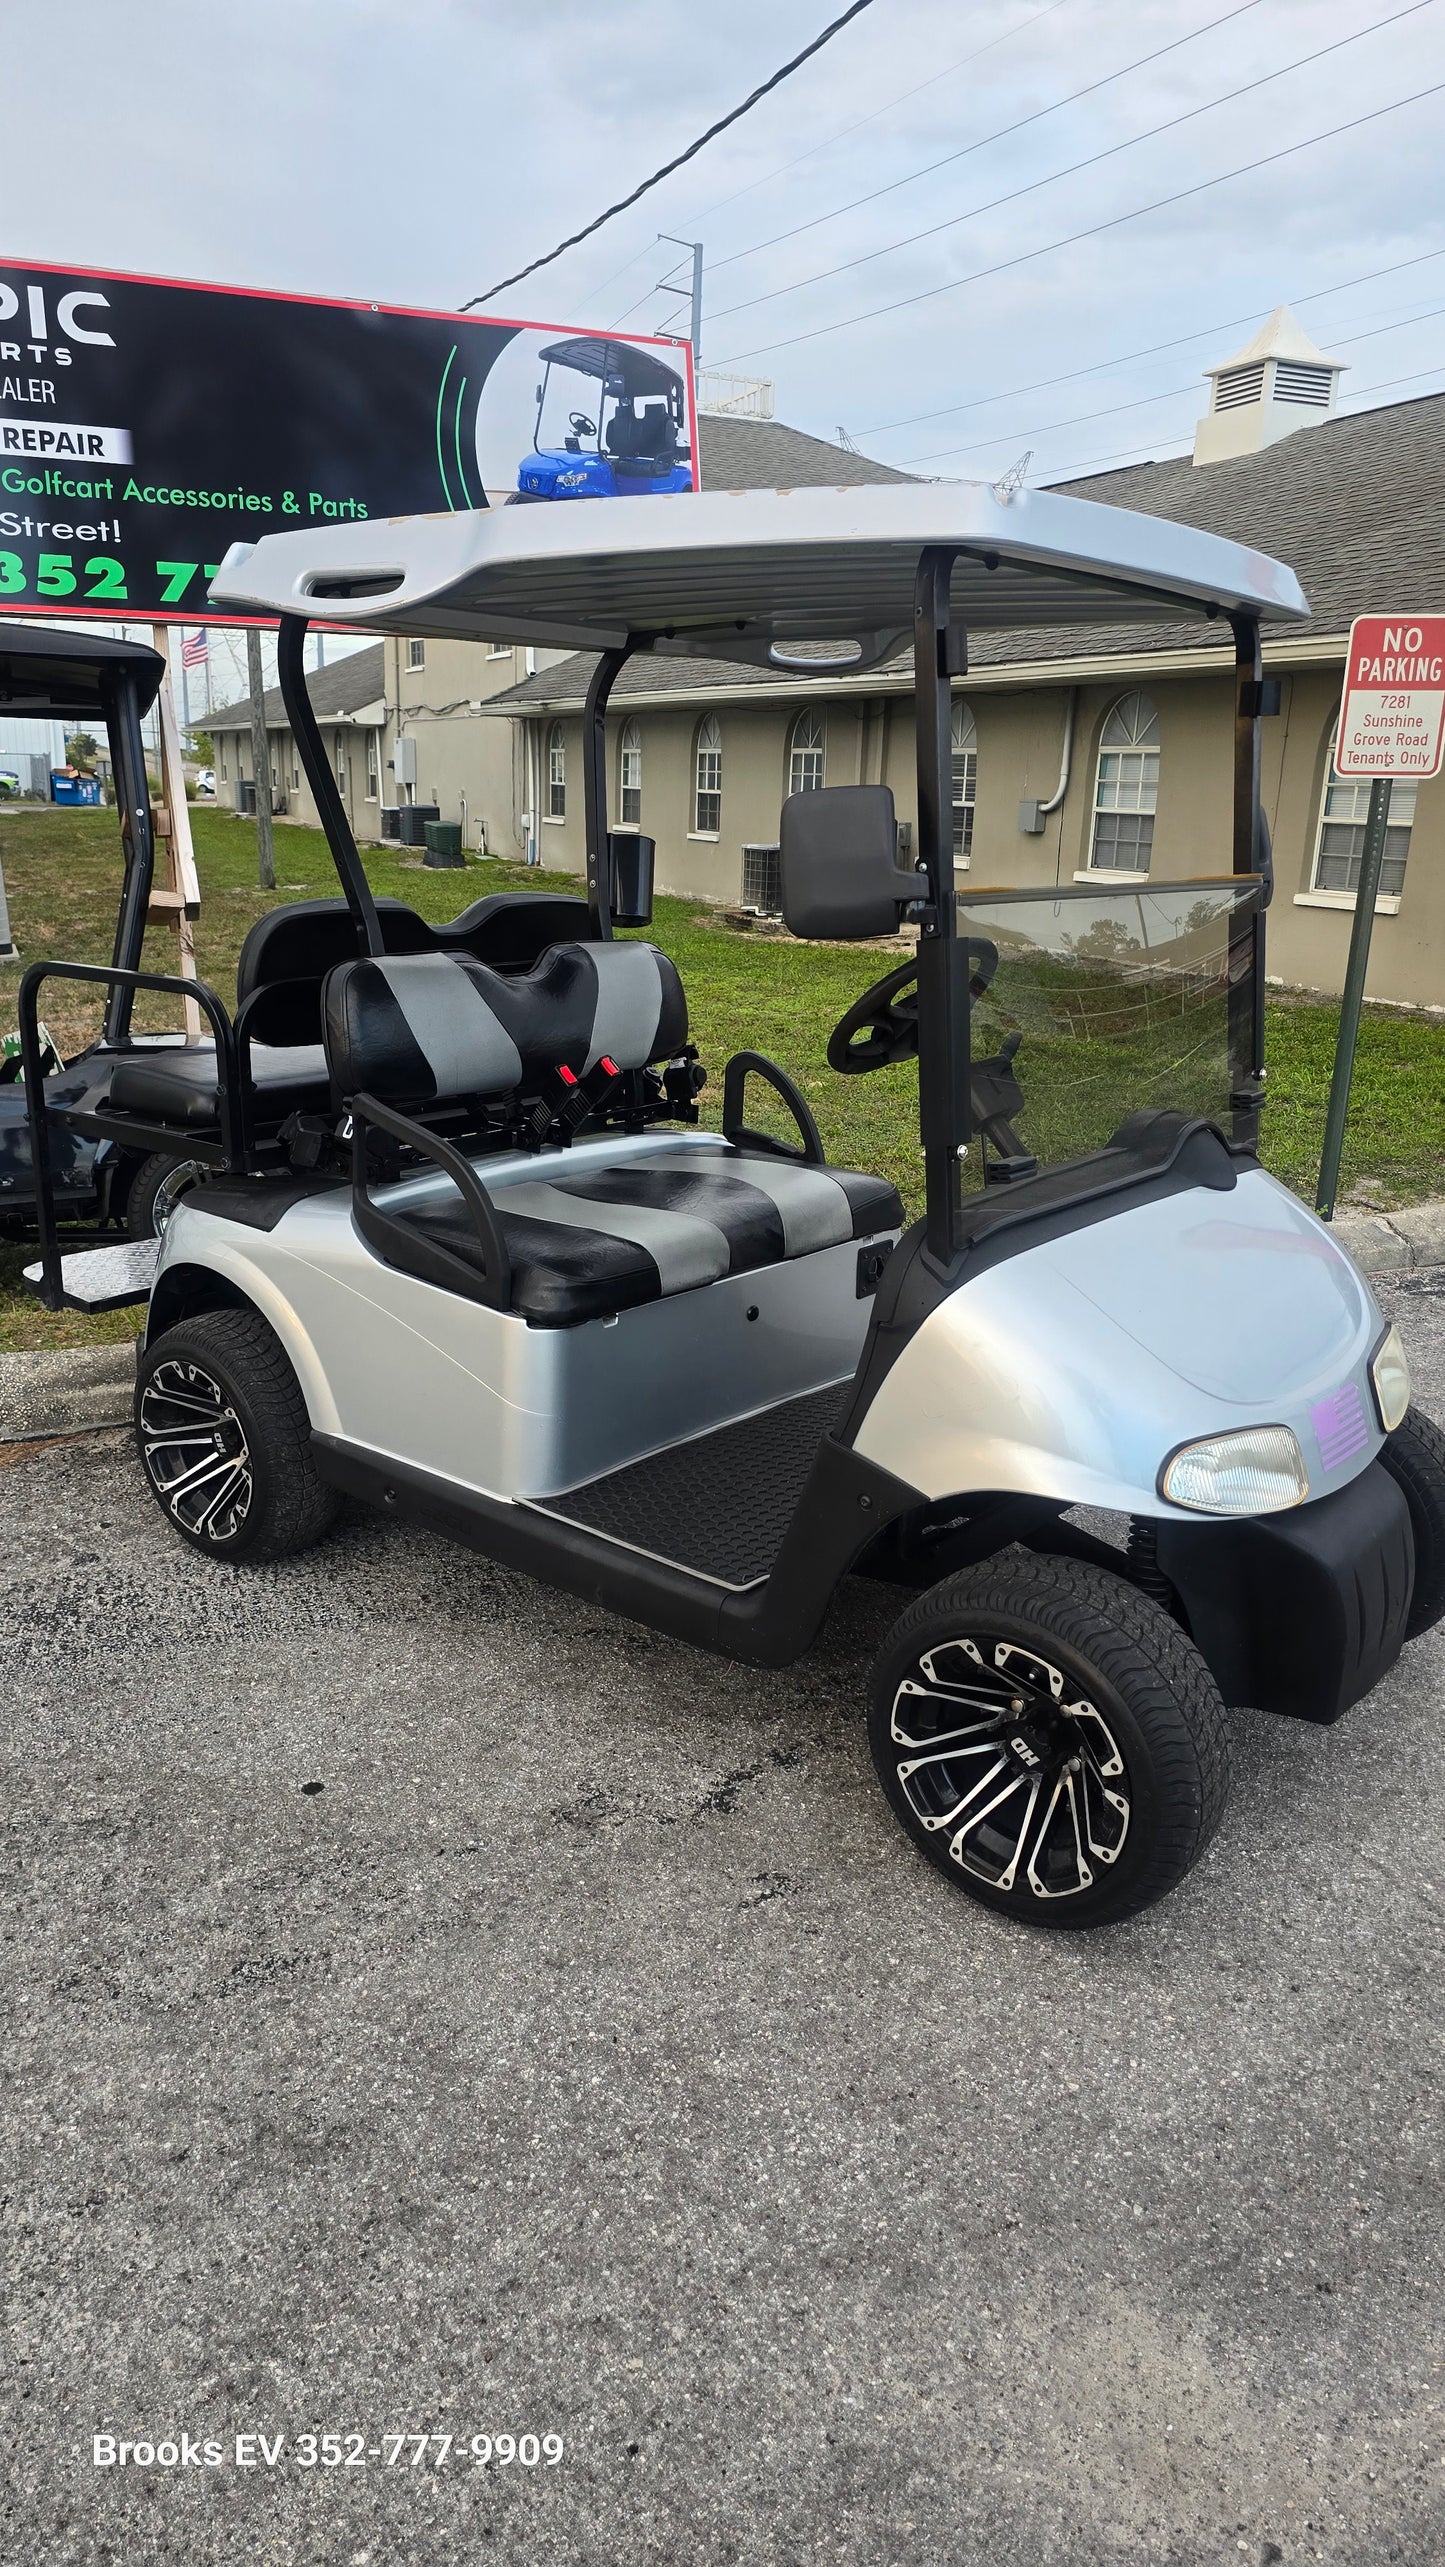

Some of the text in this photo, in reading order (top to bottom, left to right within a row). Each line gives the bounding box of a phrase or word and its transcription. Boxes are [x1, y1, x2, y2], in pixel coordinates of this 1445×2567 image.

[0, 341, 72, 366] RTS
[0, 376, 56, 404] ALER
[3, 427, 105, 457] REPAIR
[1, 468, 368, 519] Golfcart Accessories & Parts
[0, 512, 122, 543] Street!
[0, 551, 128, 600] 352
[1382, 627, 1423, 653] NO
[1357, 657, 1443, 682] PARKING
[1381, 695, 1411, 709] 7281
[1363, 714, 1423, 728] Sunshine
[1353, 732, 1429, 746] Grove Road
[1347, 750, 1430, 768] Tenants Only
[1011, 1737, 1040, 1767] HD
